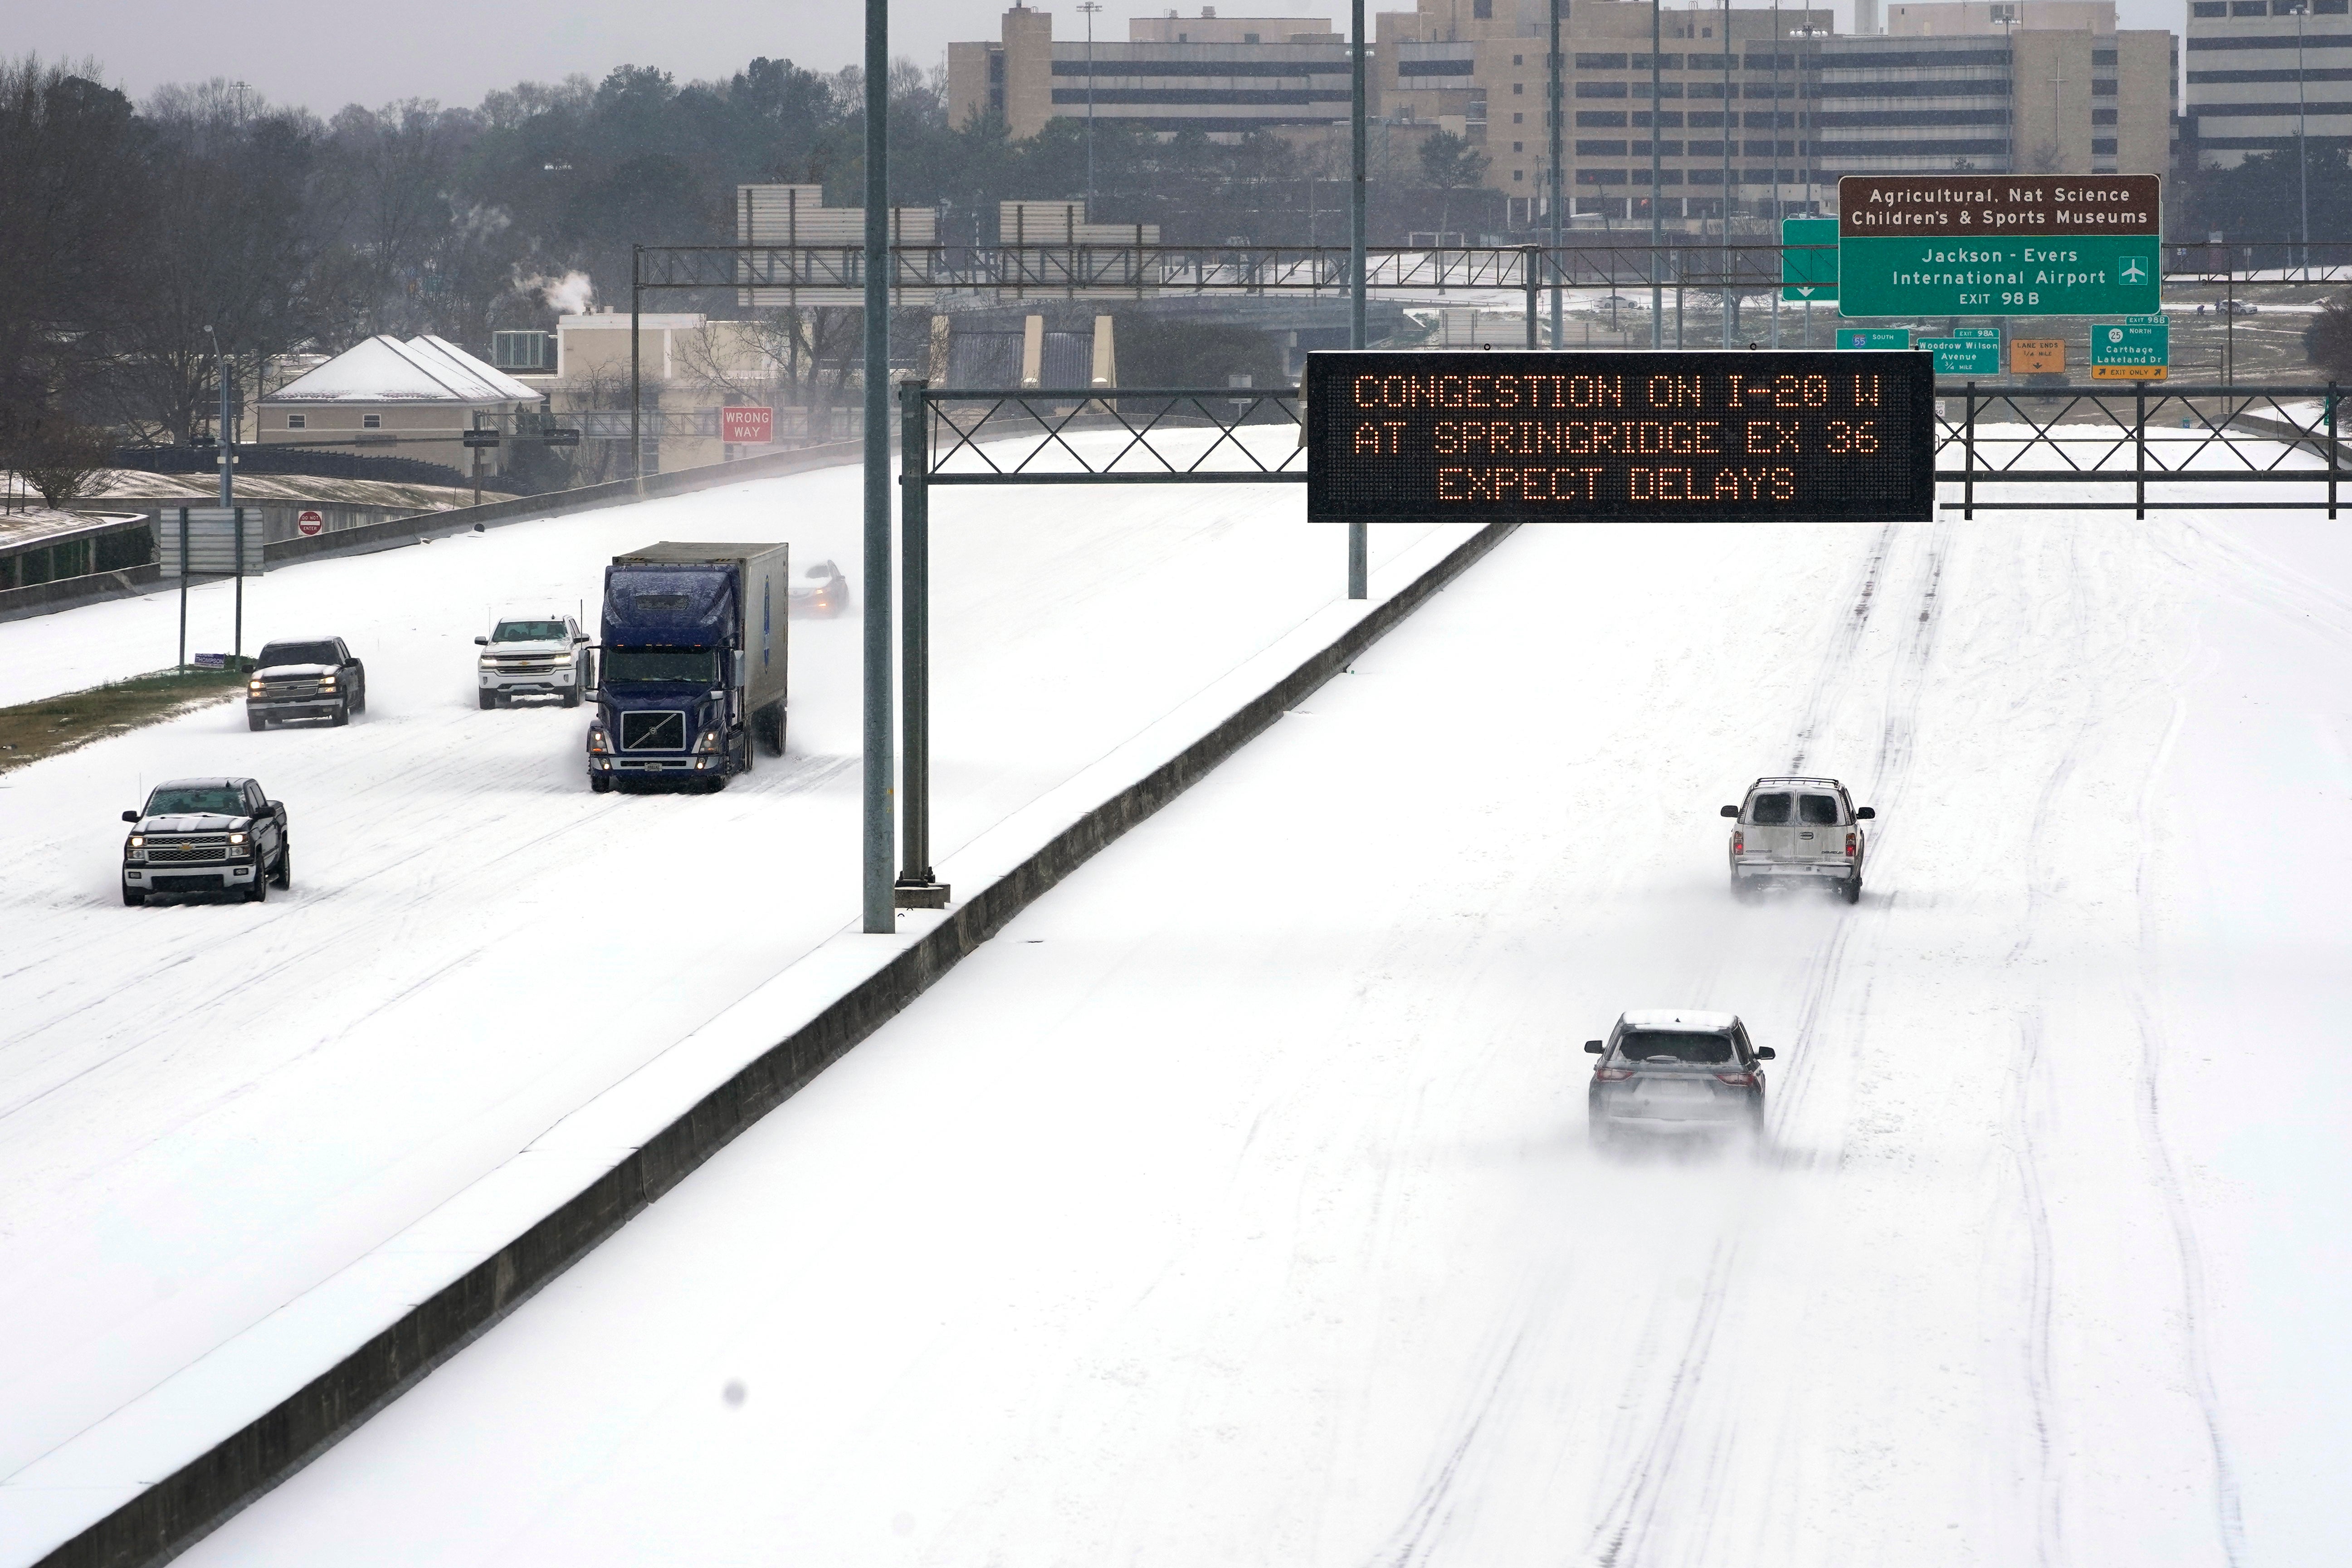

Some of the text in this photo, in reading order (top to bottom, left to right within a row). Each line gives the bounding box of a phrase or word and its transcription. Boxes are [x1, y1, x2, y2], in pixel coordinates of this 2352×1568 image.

[1869, 188, 2129, 206] Agricultural, Nat Science
[1853, 210, 2147, 227] Children's & Sports Museums
[1922, 248, 2002, 263] Jackson
[2025, 248, 2077, 262] Evers
[1894, 271, 2105, 287] International Airport
[1960, 292, 2039, 304] EXIT 98B
[1854, 337, 1865, 346] 55
[2111, 331, 2121, 340] 25
[2106, 346, 2153, 355] Carthage
[1356, 375, 1878, 407] CONGESTION ON I-20 W
[726, 413, 768, 423] WRONG
[735, 427, 760, 437] WAY
[1356, 422, 1878, 453] AT SPRINGRIDGE EX 36
[1440, 468, 1793, 499] EXPECT DELAYS
